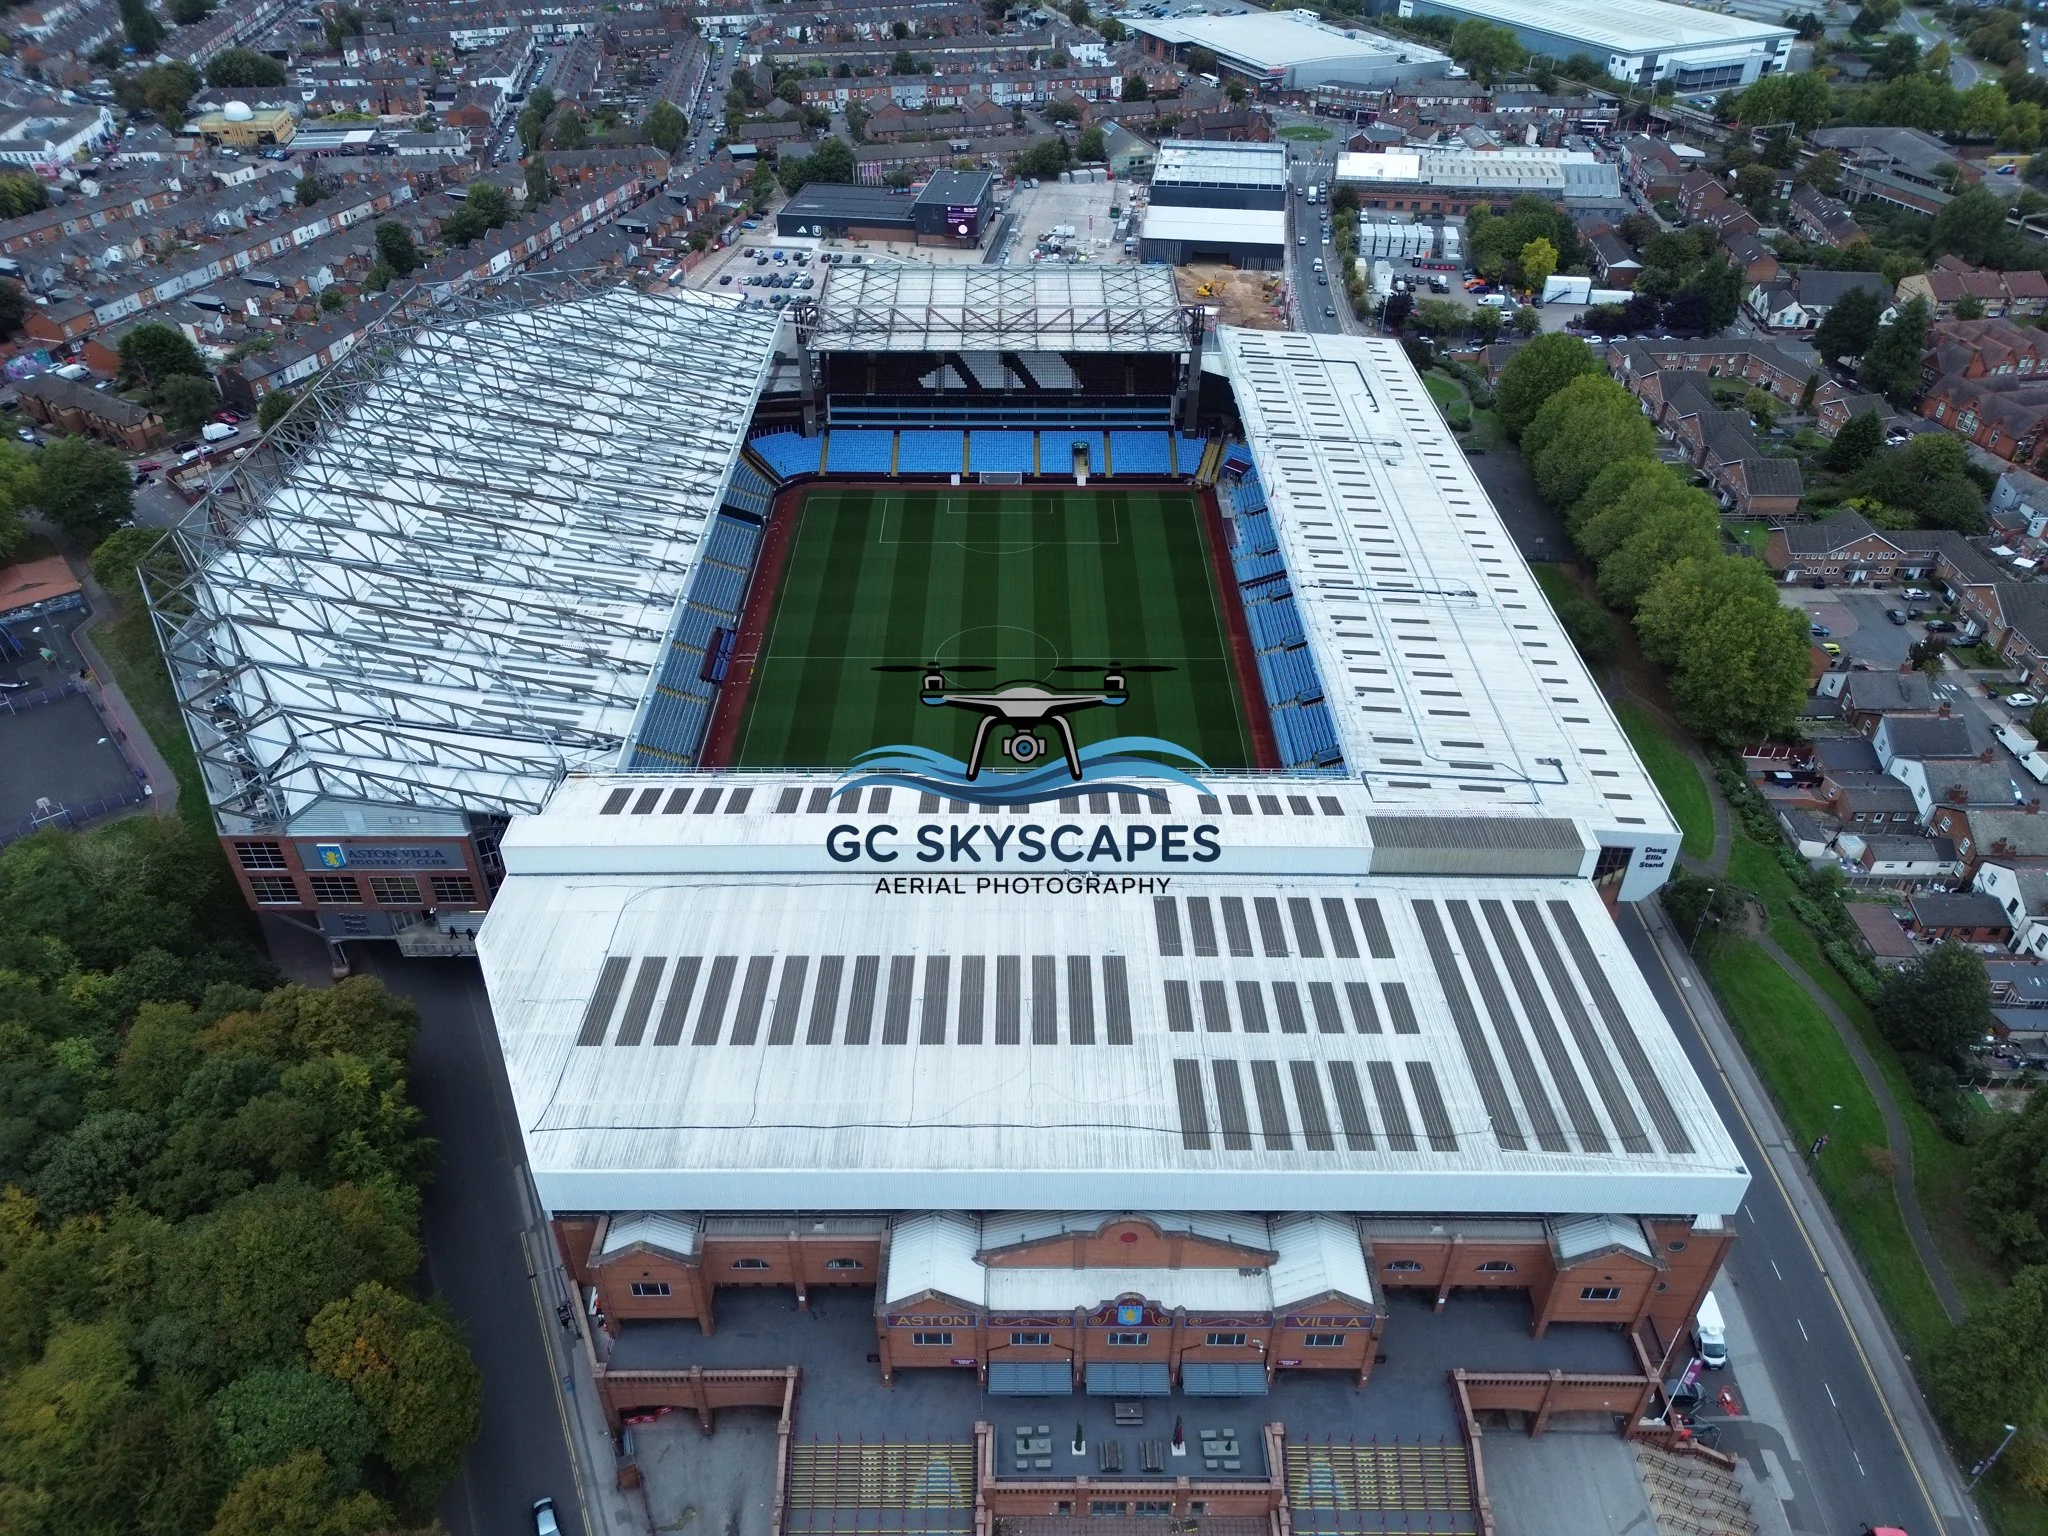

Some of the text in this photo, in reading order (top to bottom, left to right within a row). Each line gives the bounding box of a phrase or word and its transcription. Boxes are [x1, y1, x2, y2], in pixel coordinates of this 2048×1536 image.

[348, 849, 444, 858] ASTON VILLA
[896, 1316, 969, 1326] ASTON
[1296, 1317, 1360, 1327] VILLA
